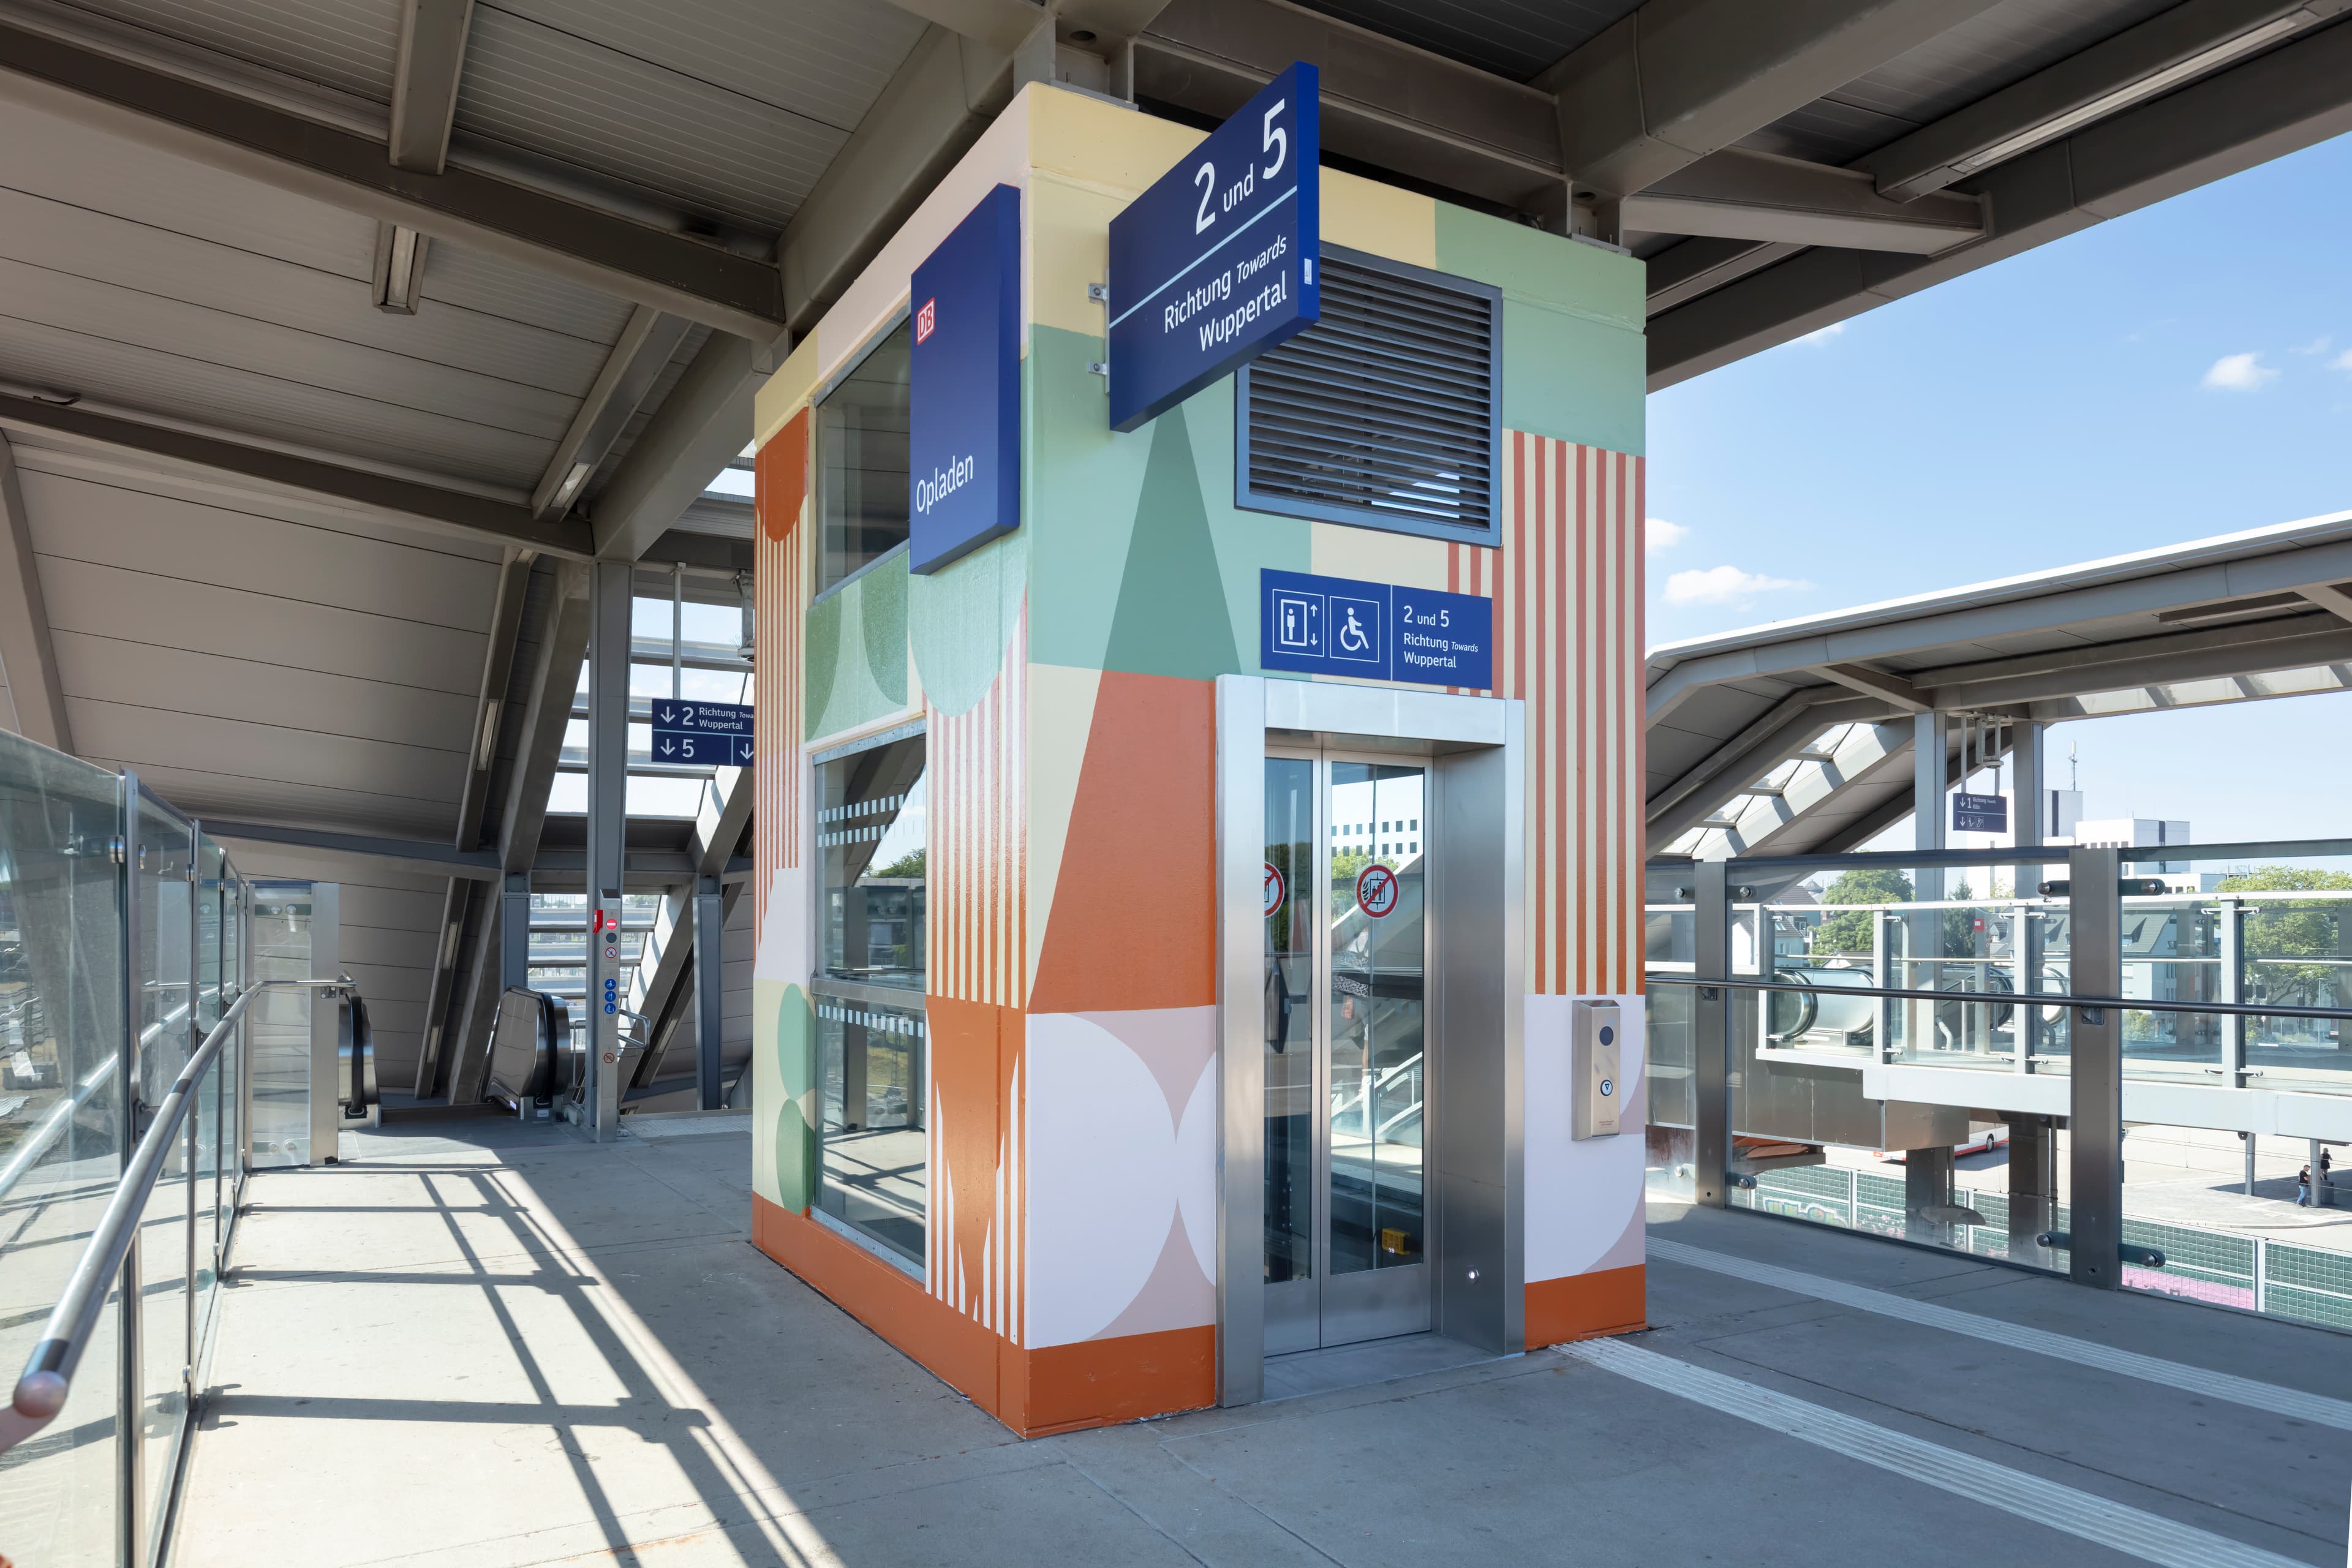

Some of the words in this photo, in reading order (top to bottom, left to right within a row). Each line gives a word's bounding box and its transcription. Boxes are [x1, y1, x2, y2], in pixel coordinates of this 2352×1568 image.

[1195, 162, 1216, 235] 2
[1223, 162, 1254, 213] und
[1262, 98, 1287, 179] 5
[1165, 270, 1231, 334] Richtung
[1237, 235, 1287, 284] Towards
[1199, 270, 1287, 352] Wuppertal
[918, 300, 935, 343] DB
[916, 455, 973, 515] Opladen
[1403, 605, 1413, 624] 2
[1417, 613, 1436, 626] und
[1440, 609, 1449, 628] 5
[1403, 632, 1449, 652] Richtung
[1451, 641, 1479, 652] Towards
[1403, 650, 1457, 668] Wuppertal
[682, 706, 694, 726] 2
[699, 707, 736, 719] Richtung
[699, 719, 743, 729] Wuppertal
[682, 739, 695, 758] 5
[1967, 797, 1972, 809] 1
